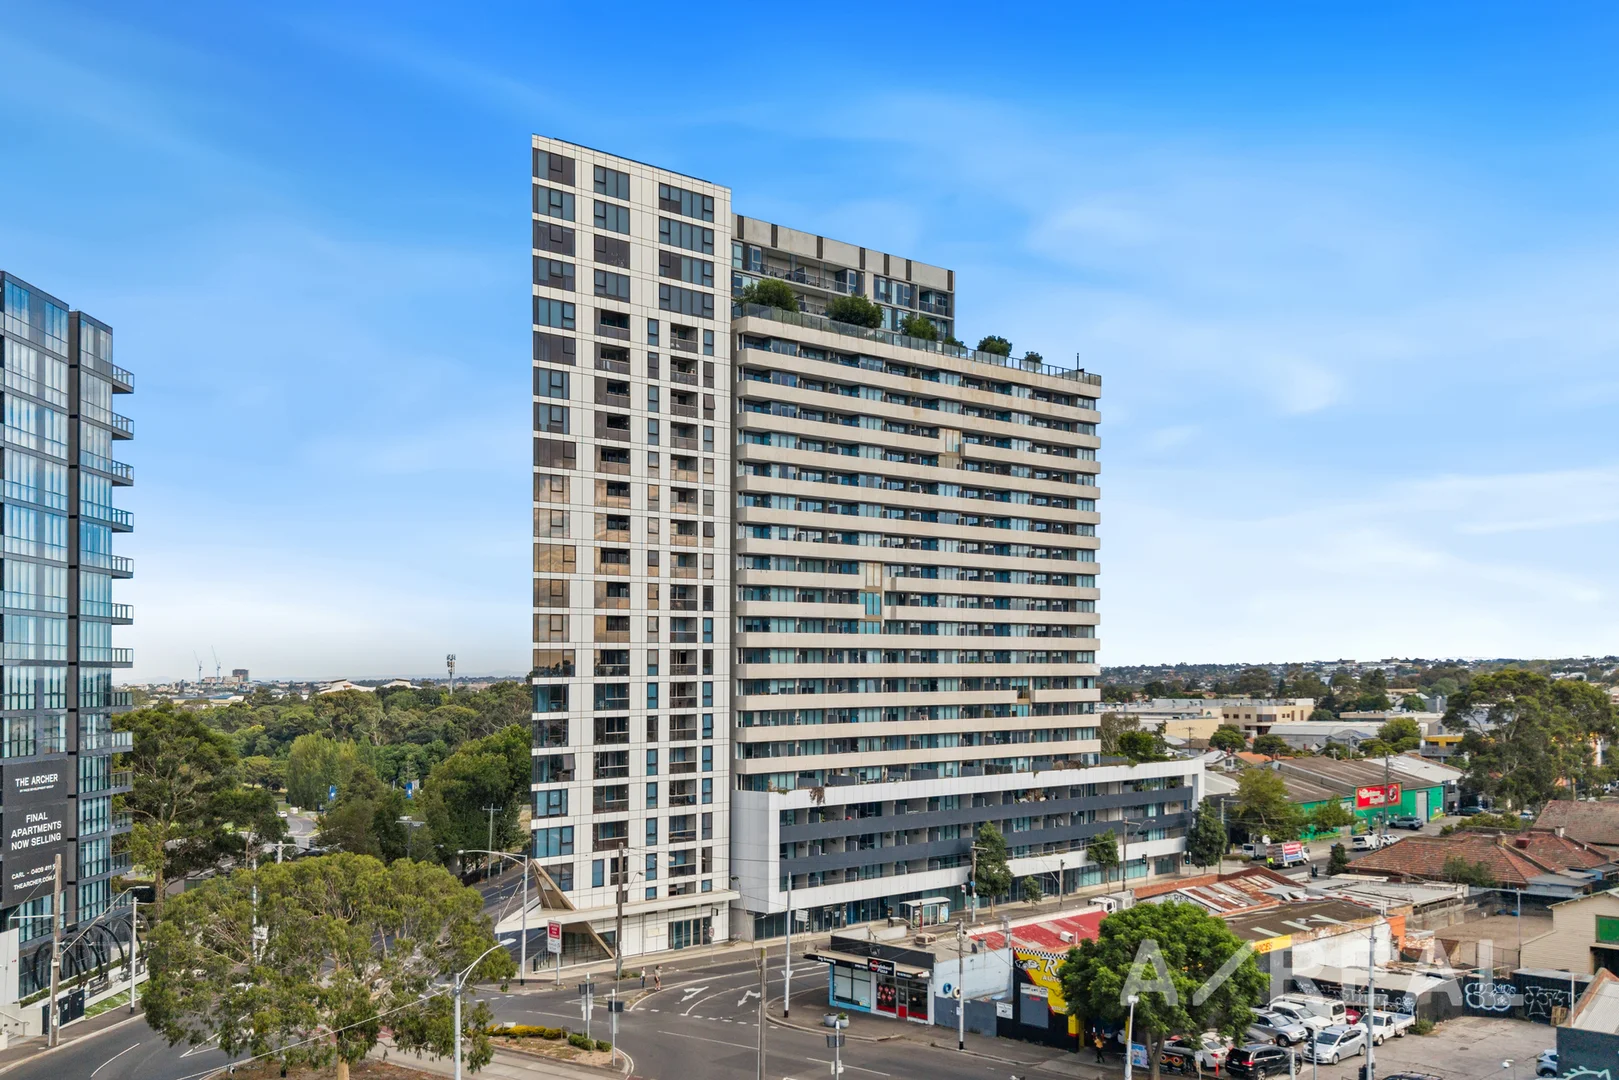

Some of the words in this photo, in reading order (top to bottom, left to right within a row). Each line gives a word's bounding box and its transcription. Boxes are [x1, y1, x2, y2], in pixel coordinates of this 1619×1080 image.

[15, 777, 29, 787] THE
[31, 773, 58, 785] ARCHER
[26, 811, 48, 823] FINAL
[11, 821, 61, 838] APARTMENTS
[11, 838, 29, 851] NOW
[31, 832, 61, 846] SELLING
[11, 871, 25, 880] CARL
